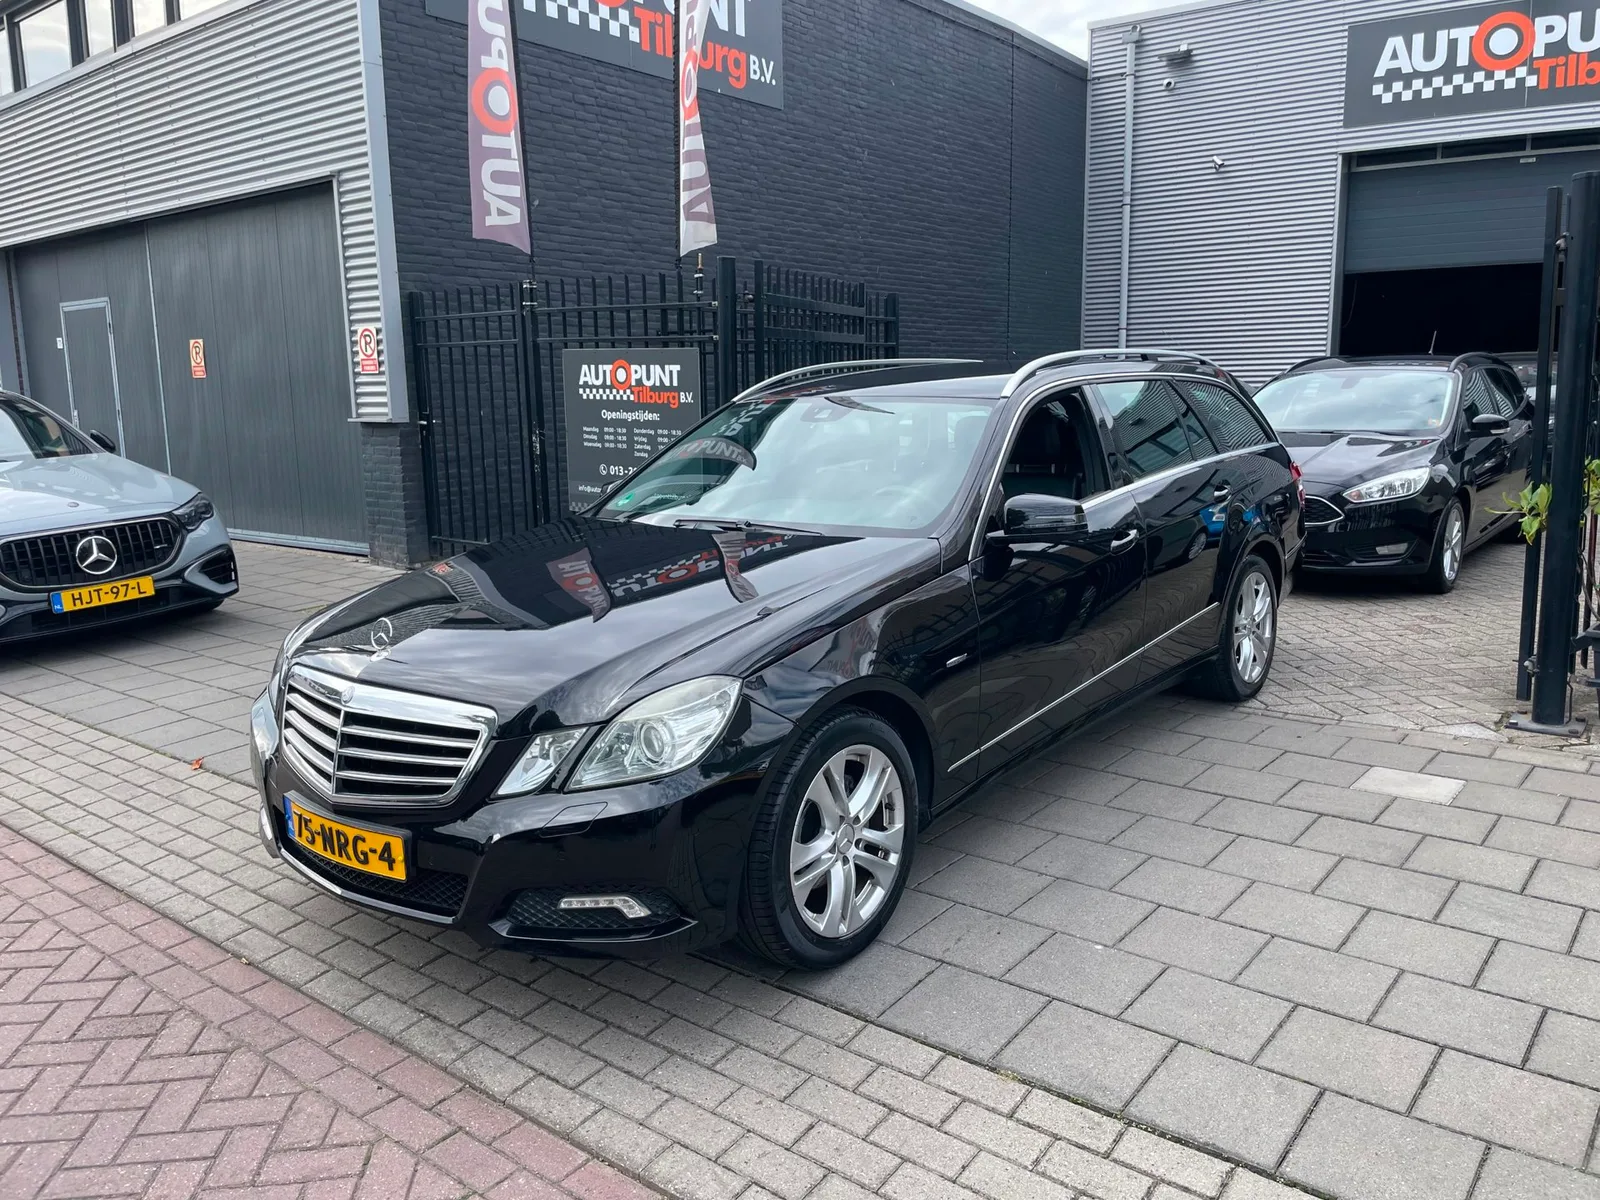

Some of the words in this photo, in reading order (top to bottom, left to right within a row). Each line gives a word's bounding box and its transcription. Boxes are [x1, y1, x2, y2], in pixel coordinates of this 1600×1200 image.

[634, 6, 747, 89] Tilurg
[750, 55, 776, 86] B.V.
[579, 359, 681, 391] AUTOPUNT
[632, 386, 679, 409] Tilburg
[680, 391, 694, 403] B.V.
[601, 409, 660, 422] Openingstijden:
[71, 582, 147, 607] HJT-97-L
[293, 809, 396, 872] 75-NRG-4
